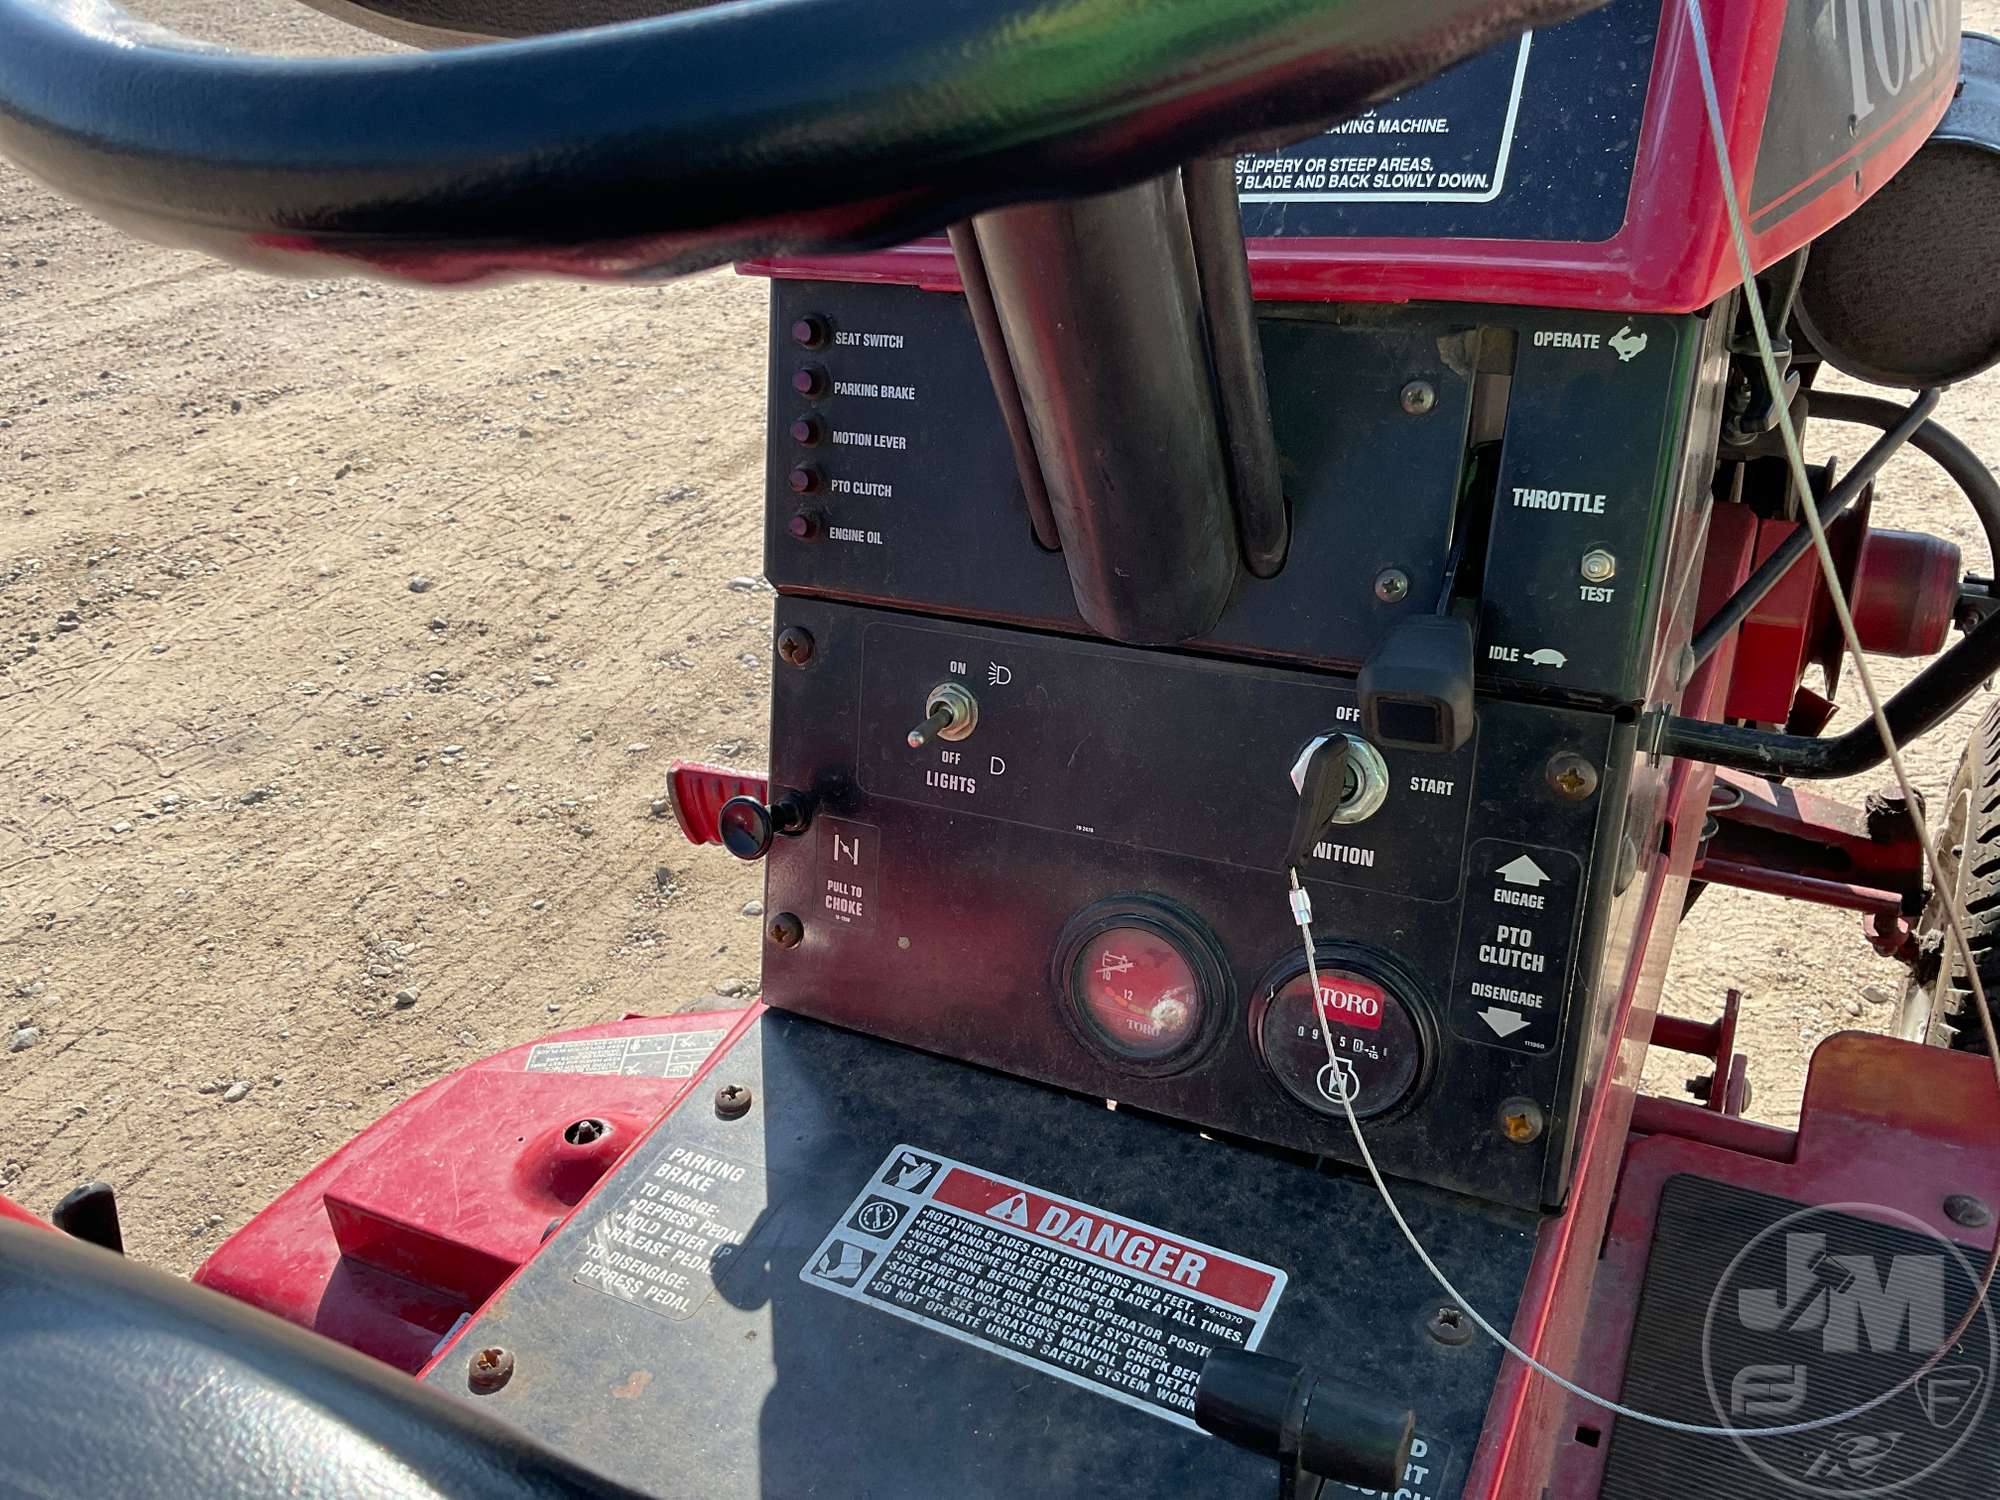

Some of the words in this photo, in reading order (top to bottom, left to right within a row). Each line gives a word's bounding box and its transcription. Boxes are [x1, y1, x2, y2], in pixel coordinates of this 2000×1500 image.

[1378, 119, 1449, 133] MACHINE.
[1235, 159, 1303, 173] SLIPPERY
[1305, 159, 1326, 172] OR
[1329, 158, 1377, 172] STEEP
[1379, 157, 1434, 171] AREAS.
[1244, 175, 1293, 189] BLADE
[1294, 175, 1325, 188] AND
[1328, 174, 1370, 188] BACK
[1373, 173, 1435, 188] SLOWLY
[1438, 173, 1489, 188] DOWN.
[835, 331, 861, 346] SEAT
[863, 333, 904, 349] SWITCH
[1533, 331, 1600, 349] OPERATE
[834, 382, 878, 397] PARKING
[881, 384, 915, 400] BRAKE
[832, 430, 872, 447] MOTION
[874, 434, 906, 450] LEVER
[831, 479, 850, 493] PTO
[853, 481, 892, 498] CLUTCH
[1512, 488, 1606, 514] THROTTLE
[829, 527, 865, 542] ENGINE
[867, 531, 883, 545] OIL
[1580, 586, 1614, 603] TEST
[1488, 645, 1519, 662] IDLE
[950, 660, 966, 675] ON
[1336, 706, 1360, 722] OFF
[942, 751, 961, 765] OFF
[926, 770, 976, 794] LIGHTS
[1410, 776, 1454, 796] START
[1312, 841, 1375, 867] NITION
[827, 880, 848, 894] PULL
[851, 885, 862, 898] TO
[1494, 888, 1544, 910] ENGAGE
[825, 895, 862, 916] CHOKE
[1497, 925, 1532, 947] PTO
[1479, 945, 1544, 973] CLUTCH
[1123, 989, 1134, 1000] 12
[1319, 987, 1378, 1016] TORO
[1471, 982, 1543, 1008] DISENGAGE
[668, 1147, 746, 1182] PARKING
[655, 1163, 715, 1192] BRAKE
[640, 1182, 660, 1197] TO
[660, 1189, 720, 1218] ENGAGE:
[661, 1227, 709, 1251] LEVER
[709, 1242, 732, 1259] UP
[698, 1220, 744, 1246] PEDAL
[1036, 1204, 1207, 1287] DANGER
[585, 1242, 604, 1259] TO
[606, 1251, 690, 1291] DISENGAGE:
[671, 1249, 717, 1275] PEDAL
[983, 1229, 1030, 1252] BLADES
[1031, 1246, 1058, 1262] CAN
[1059, 1256, 1086, 1272] CUT
[1086, 1266, 1131, 1288] HANDS
[1131, 1283, 1160, 1299] AND
[1162, 1293, 1194, 1312] FEET.
[578, 1260, 644, 1293] DEPRESS
[644, 1285, 691, 1313] PEDAL
[948, 1243, 1001, 1268] ASSUME
[1001, 1261, 1041, 1282] BLADE
[1041, 1275, 1056, 1287] IS
[1056, 1281, 1114, 1310] STOPPED.
[949, 1229, 992, 1251] HANDS
[991, 1245, 1019, 1260] AND
[1019, 1254, 1050, 1271] FEET
[1049, 1265, 1090, 1287] CLEAR
[1091, 1280, 1109, 1293] OF
[1108, 1286, 1151, 1309] BLADE
[1151, 1302, 1171, 1315] AT
[1171, 1310, 1195, 1326] ALL
[1200, 1318, 1243, 1343] TIMES.
[939, 1251, 984, 1274] ENGINE
[986, 1268, 1033, 1292] BEFORE
[1036, 1286, 1089, 1313] LEAVING
[1094, 1308, 1162, 1340] OPERATOR
[921, 1259, 957, 1278] CARE!
[956, 1271, 975, 1285] DO
[975, 1278, 1003, 1295] NOT
[1002, 1288, 1034, 1306] RELY
[1034, 1301, 1054, 1314] ON
[1054, 1308, 1103, 1332] SAFETY
[1104, 1326, 1167, 1358] SYSTEMS.
[1203, 1303, 1243, 1325] 79-0370
[881, 1270, 915, 1289] EACH
[918, 1284, 945, 1301] USE.
[949, 1296, 974, 1312] SEE
[1058, 1336, 1115, 1366] MANUAL
[1122, 1360, 1149, 1378] FOR
[1154, 1372, 1196, 1396] DETAI
[933, 1276, 1000, 1309] INTERLOCK
[1000, 1302, 1061, 1330] SYSTEMS
[1061, 1324, 1090, 1342] CAN
[1091, 1335, 1121, 1355] FAIL.
[1125, 1348, 1170, 1372] CHECK
[895, 1289, 922, 1304] NOT
[924, 1300, 981, 1328] OPERATE
[985, 1322, 1035, 1348] UNLESS
[1039, 1344, 1089, 1369] SAFETY
[1094, 1364, 1150, 1392] SYSTEM
